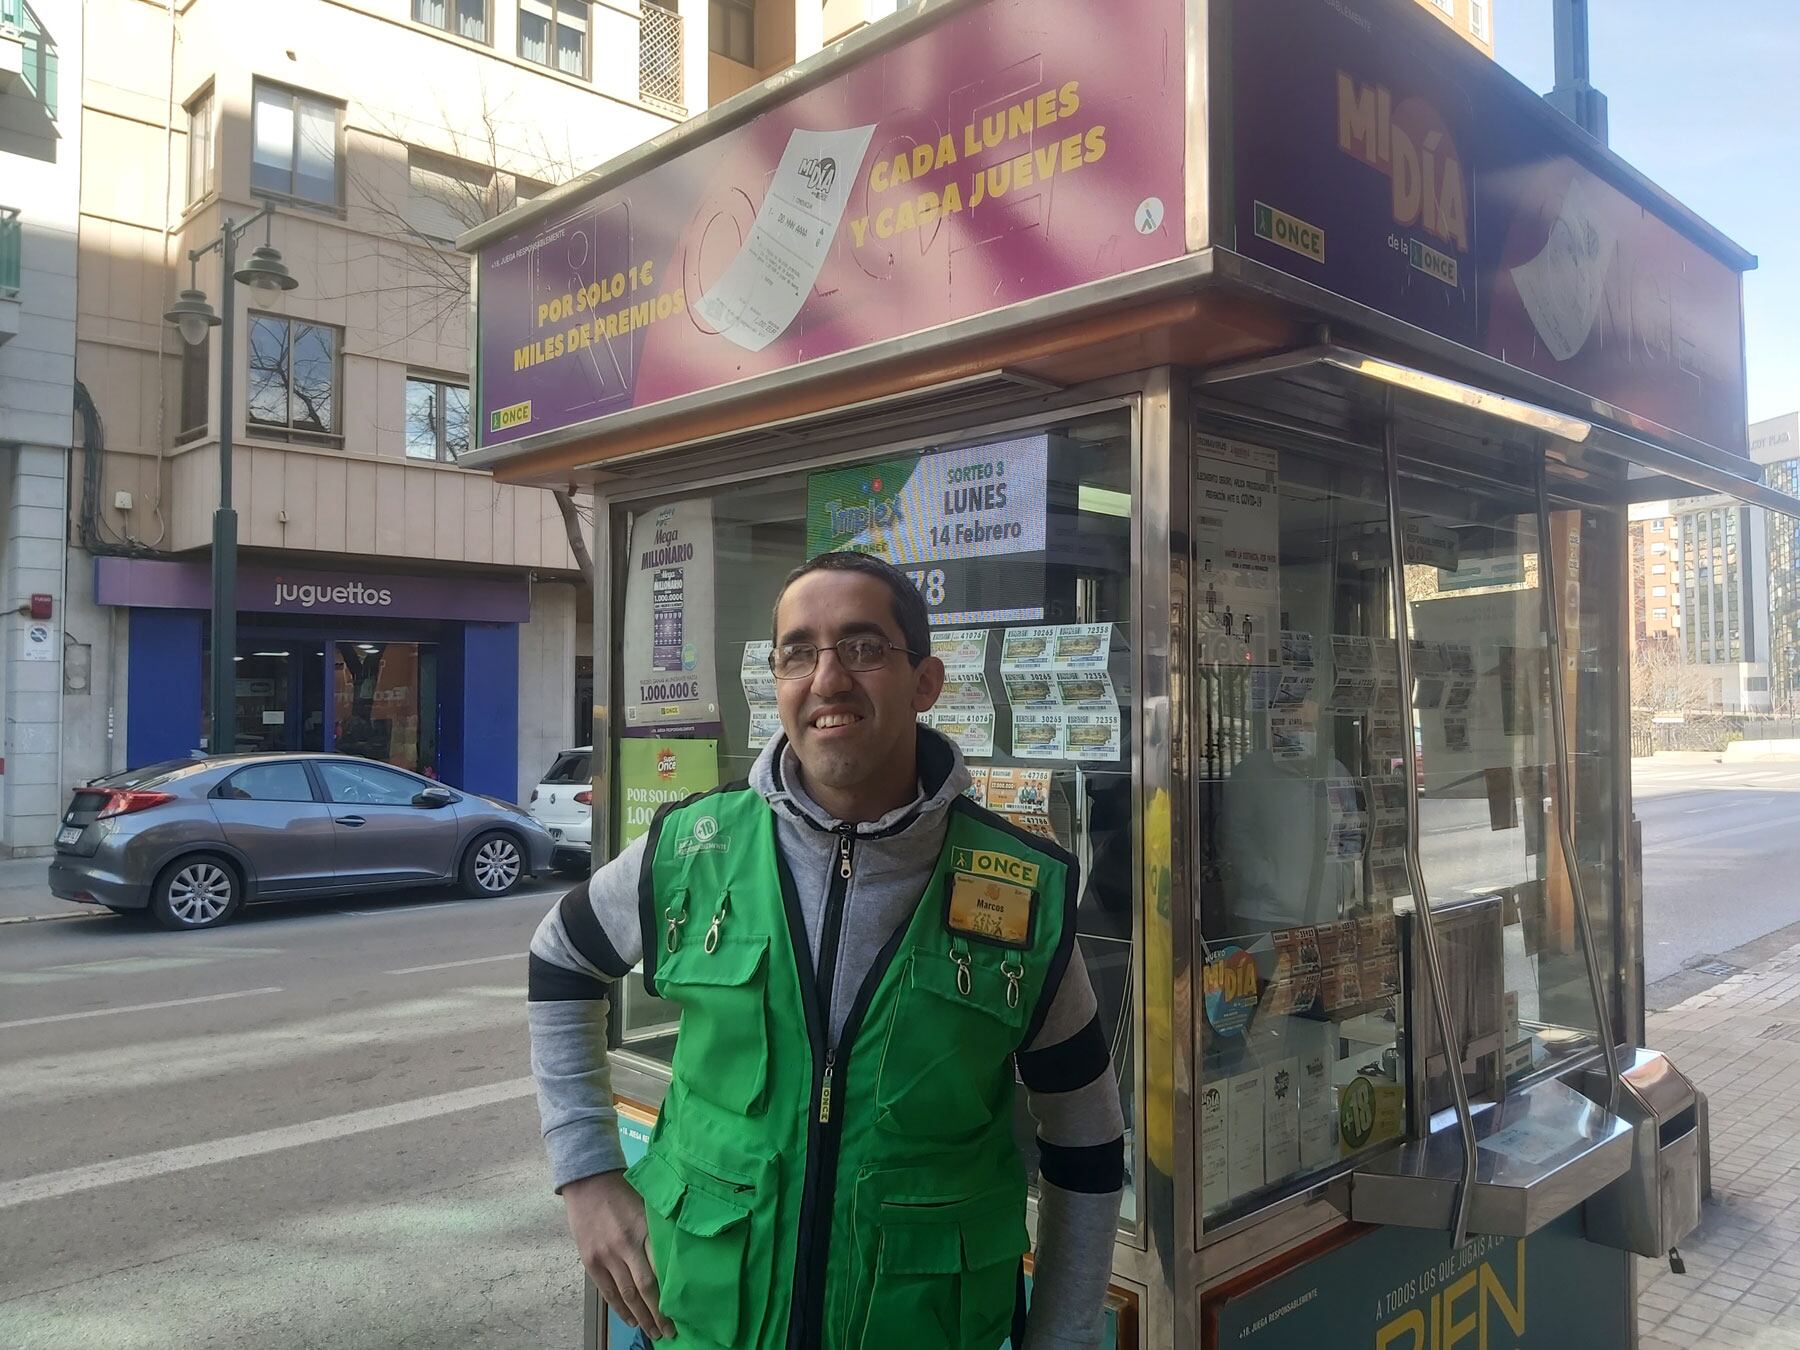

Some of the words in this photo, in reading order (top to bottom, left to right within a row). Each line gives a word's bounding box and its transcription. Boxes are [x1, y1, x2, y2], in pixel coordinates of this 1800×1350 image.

[870, 133, 957, 192] CADA
[965, 80, 1079, 156] LUNES
[1338, 72, 1392, 163] MI
[1391, 123, 1467, 252] DÍA
[850, 216, 869, 248] Y
[875, 183, 963, 239] CADA
[968, 125, 1106, 207] JUEVES
[1275, 217, 1320, 254] ONCE
[1387, 233, 1399, 250] de
[1424, 253, 1454, 280] ONCE
[538, 294, 574, 328] POR
[576, 272, 626, 312] SOLO
[513, 334, 564, 372] MILES
[567, 322, 590, 352] DE
[594, 288, 685, 344] PREMIOS
[502, 406, 529, 424] ONCE
[947, 465, 993, 484] SORTEO
[997, 460, 1005, 477] 3
[944, 482, 1007, 515] LUNES
[655, 529, 679, 547] Mega
[930, 525, 951, 547] 14
[955, 519, 1022, 545] Febrero
[641, 542, 694, 571] MILLONARIO
[274, 576, 392, 607] juguettos
[1033, 629, 1054, 637] 30265
[1087, 626, 1109, 634] 72358
[1084, 672, 1107, 680] 72358
[640, 681, 689, 701] 1.000.000
[691, 681, 699, 697] €
[1041, 715, 1062, 723] 30265
[1096, 716, 1118, 724] 72358
[657, 760, 677, 772] Once
[1027, 771, 1048, 780] 47786
[627, 788, 648, 802] POR
[648, 788, 678, 803] SOLO
[978, 855, 1033, 882] ONCE
[976, 898, 1005, 913] Marcos
[1204, 949, 1226, 964] NUEVO
[821, 1089, 830, 1120] ONCE
[1343, 1084, 1371, 1138] +18
[1376, 1298, 1382, 1321] A
[1386, 1279, 1416, 1314] TODOS
[1419, 1267, 1436, 1294] LOS
[1438, 1255, 1455, 1282] QUE
[1250, 1316, 1268, 1334] JUEGA
[1268, 1287, 1319, 1323] RESPONSABLEMENTE
